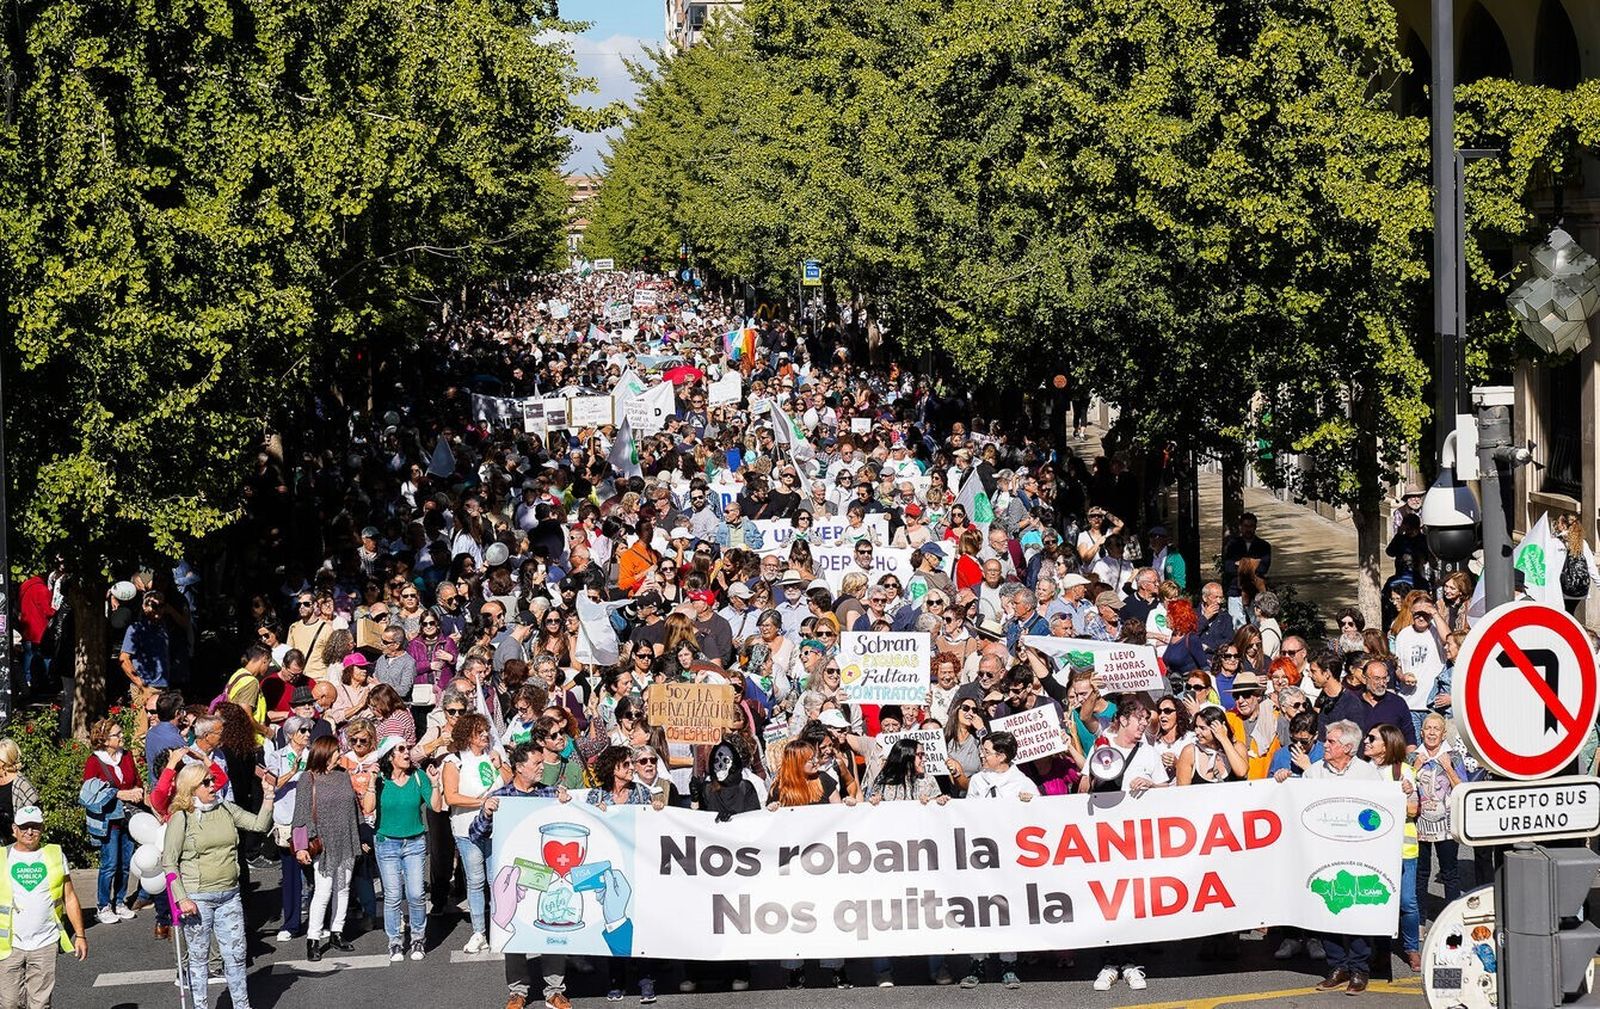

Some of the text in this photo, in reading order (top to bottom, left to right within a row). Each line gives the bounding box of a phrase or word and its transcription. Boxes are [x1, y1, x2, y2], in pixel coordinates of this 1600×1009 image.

[819, 555, 897, 571] DERHO
[853, 634, 919, 655] Sobran
[862, 654, 920, 668] EXCUSAS
[1109, 651, 1135, 661] LLEVO
[1104, 660, 1146, 672] 23 HORAS
[860, 667, 920, 686] Faltan
[1102, 669, 1158, 682] RABAJANDO,
[1122, 679, 1150, 689] CURO?
[666, 684, 714, 703] SOY LA
[844, 685, 926, 701] CONTRATOS
[684, 726, 721, 743] ESPERO
[884, 730, 941, 745] CON AGENDAS
[1013, 720, 1051, 738] CHANDO,
[1015, 742, 1056, 760] URANDO!
[1475, 790, 1587, 811] EXCEPTO BUS
[1499, 813, 1568, 831] URBANO
[660, 809, 1283, 876] Nos roban la SANIDAD
[712, 871, 1236, 940] Nos quitan la VIDA
